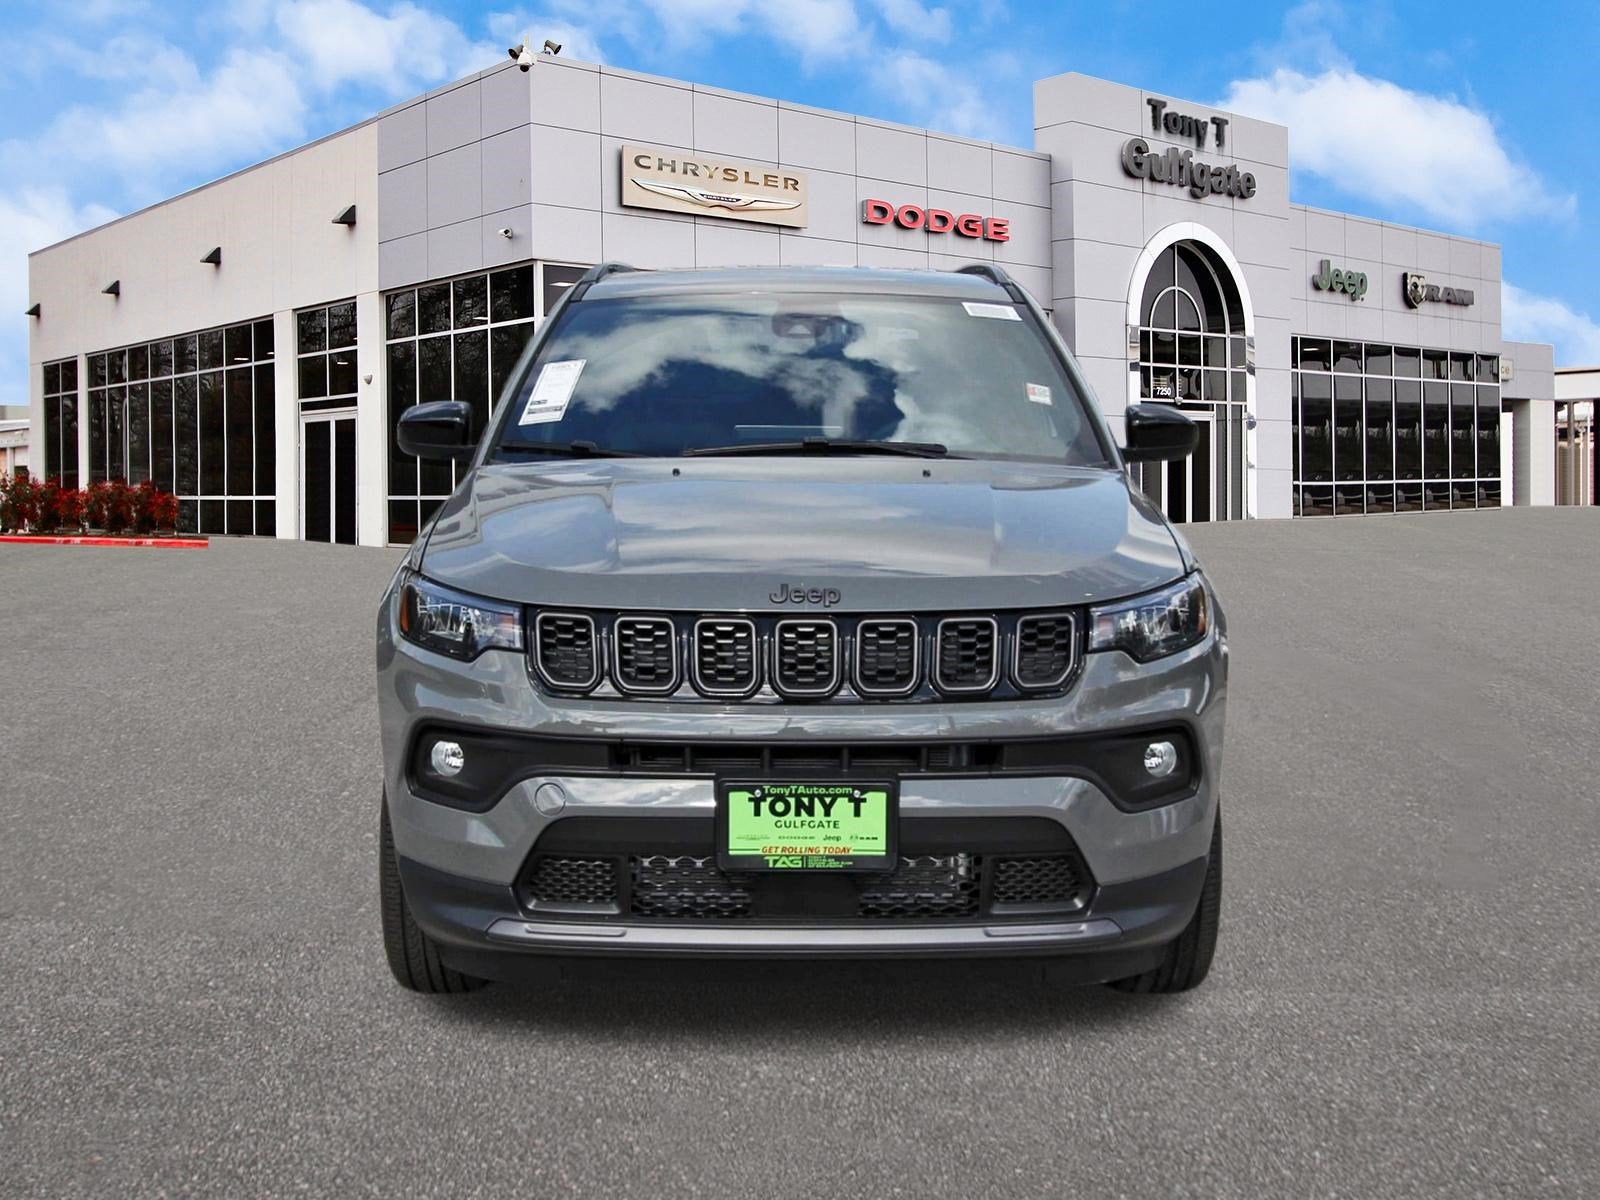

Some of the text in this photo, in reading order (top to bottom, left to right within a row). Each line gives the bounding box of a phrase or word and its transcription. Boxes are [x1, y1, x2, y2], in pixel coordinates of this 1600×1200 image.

[1147, 98, 1229, 148] Tony T
[633, 153, 801, 193] CHRYSLER
[1121, 137, 1257, 199] Gulfgate
[862, 197, 1010, 243] DODGE
[1312, 259, 1368, 302] Jeep
[1425, 283, 1475, 307] RAM
[768, 583, 841, 609] Jeep
[763, 785, 853, 796] TonyTAuto.com
[748, 796, 867, 818] TONY T
[774, 820, 840, 829] GULFGATE
[822, 833, 842, 842] Jeep
[761, 846, 853, 855] GET ROLLING TODAY
[763, 856, 803, 868] TAG
